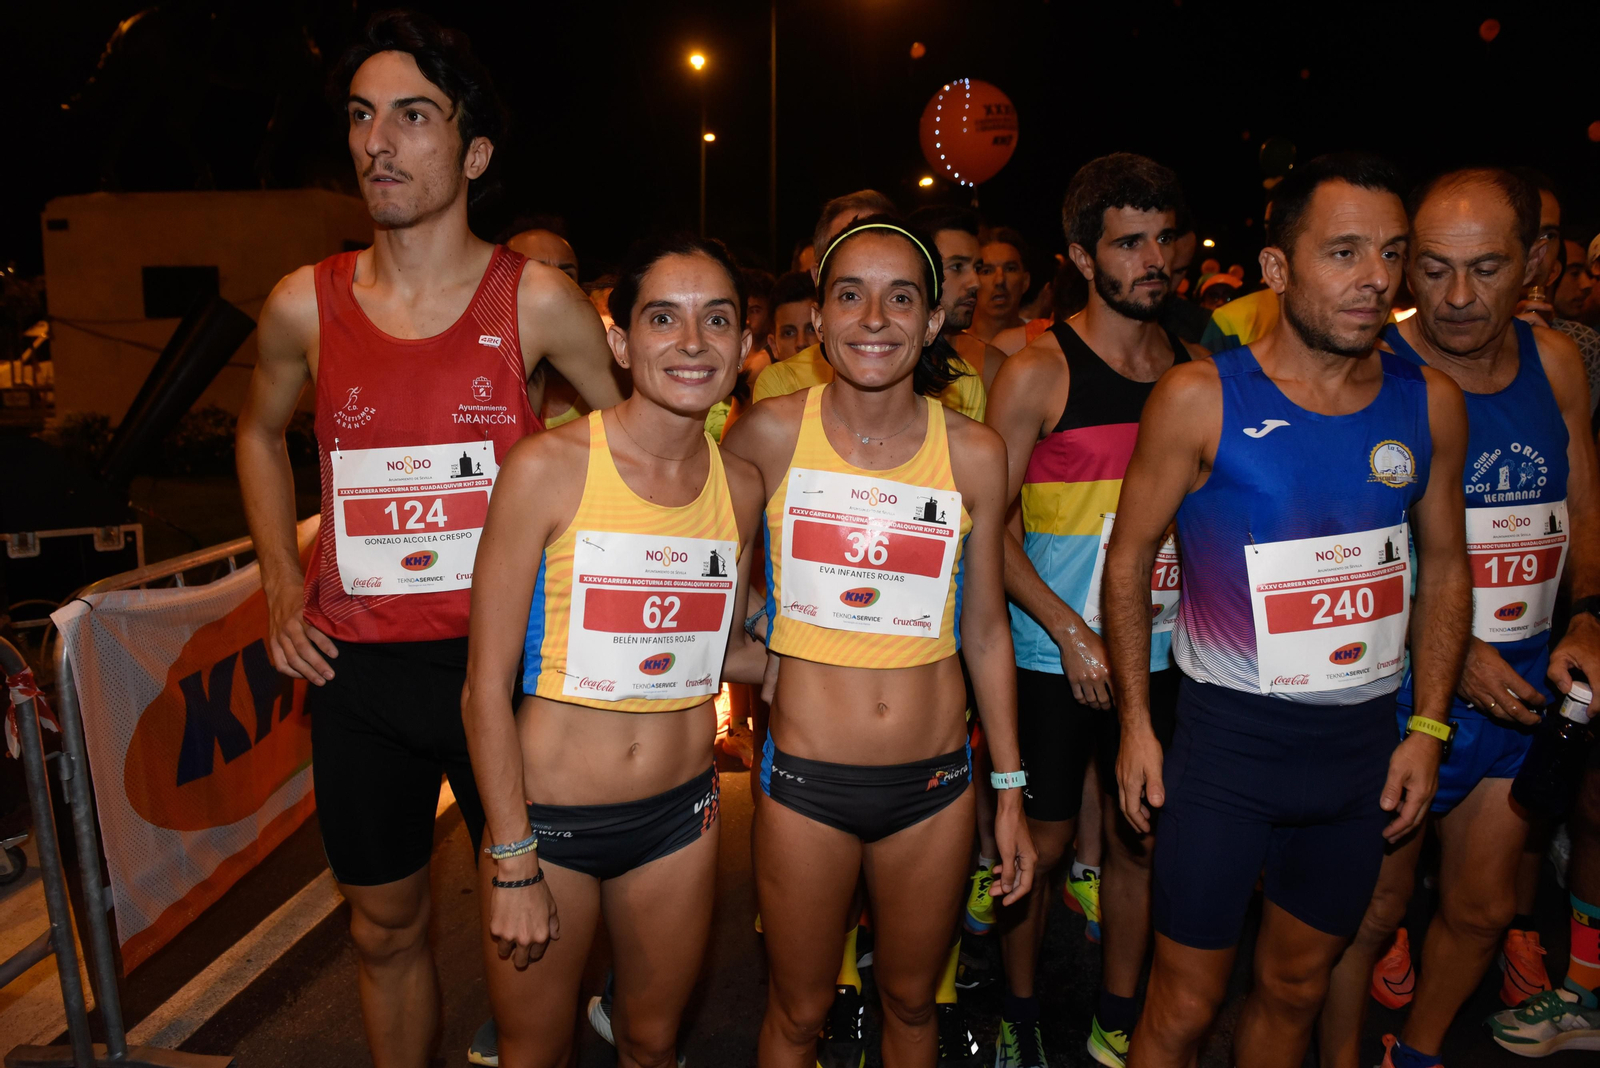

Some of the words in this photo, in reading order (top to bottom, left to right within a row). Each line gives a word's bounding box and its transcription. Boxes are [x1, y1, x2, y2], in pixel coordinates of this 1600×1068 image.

[338, 406, 369, 422] ATLETISMO
[459, 403, 507, 412] Ayuntamiento
[452, 412, 516, 424] TARANCÓN
[1471, 448, 1502, 482] ATLETISMO
[1474, 452, 1490, 469] CLUB
[420, 483, 463, 491] GUADALQUIVIR
[1465, 483, 1490, 494] DOS
[1484, 489, 1541, 503] HERMANAS
[385, 498, 447, 530] 124
[809, 509, 835, 519] CARRERA
[836, 514, 868, 524] NOCTURNA
[880, 518, 923, 532] DALQUIVIR
[936, 528, 950, 536] 2023
[364, 536, 401, 546] GONZALO
[403, 534, 438, 544] ALCOLEA
[439, 532, 472, 542] CRESPO
[1482, 541, 1511, 549] NOCTURNA
[845, 531, 889, 566] 36
[456, 571, 473, 580] Cruz
[820, 565, 836, 575] EVA
[838, 568, 875, 580] INFANTES
[877, 572, 905, 583] ROJAS
[1156, 565, 1180, 588] 18
[1307, 577, 1339, 585] NOCTURNA
[1350, 569, 1387, 579] GUADALQUIVIR
[1484, 553, 1538, 584] 179
[603, 577, 632, 585] CARRERA
[643, 595, 681, 628] 62
[1311, 587, 1374, 625] 240
[613, 635, 638, 644] BELÉN
[640, 635, 674, 644] INFANTES
[675, 635, 696, 643] ROJAS
